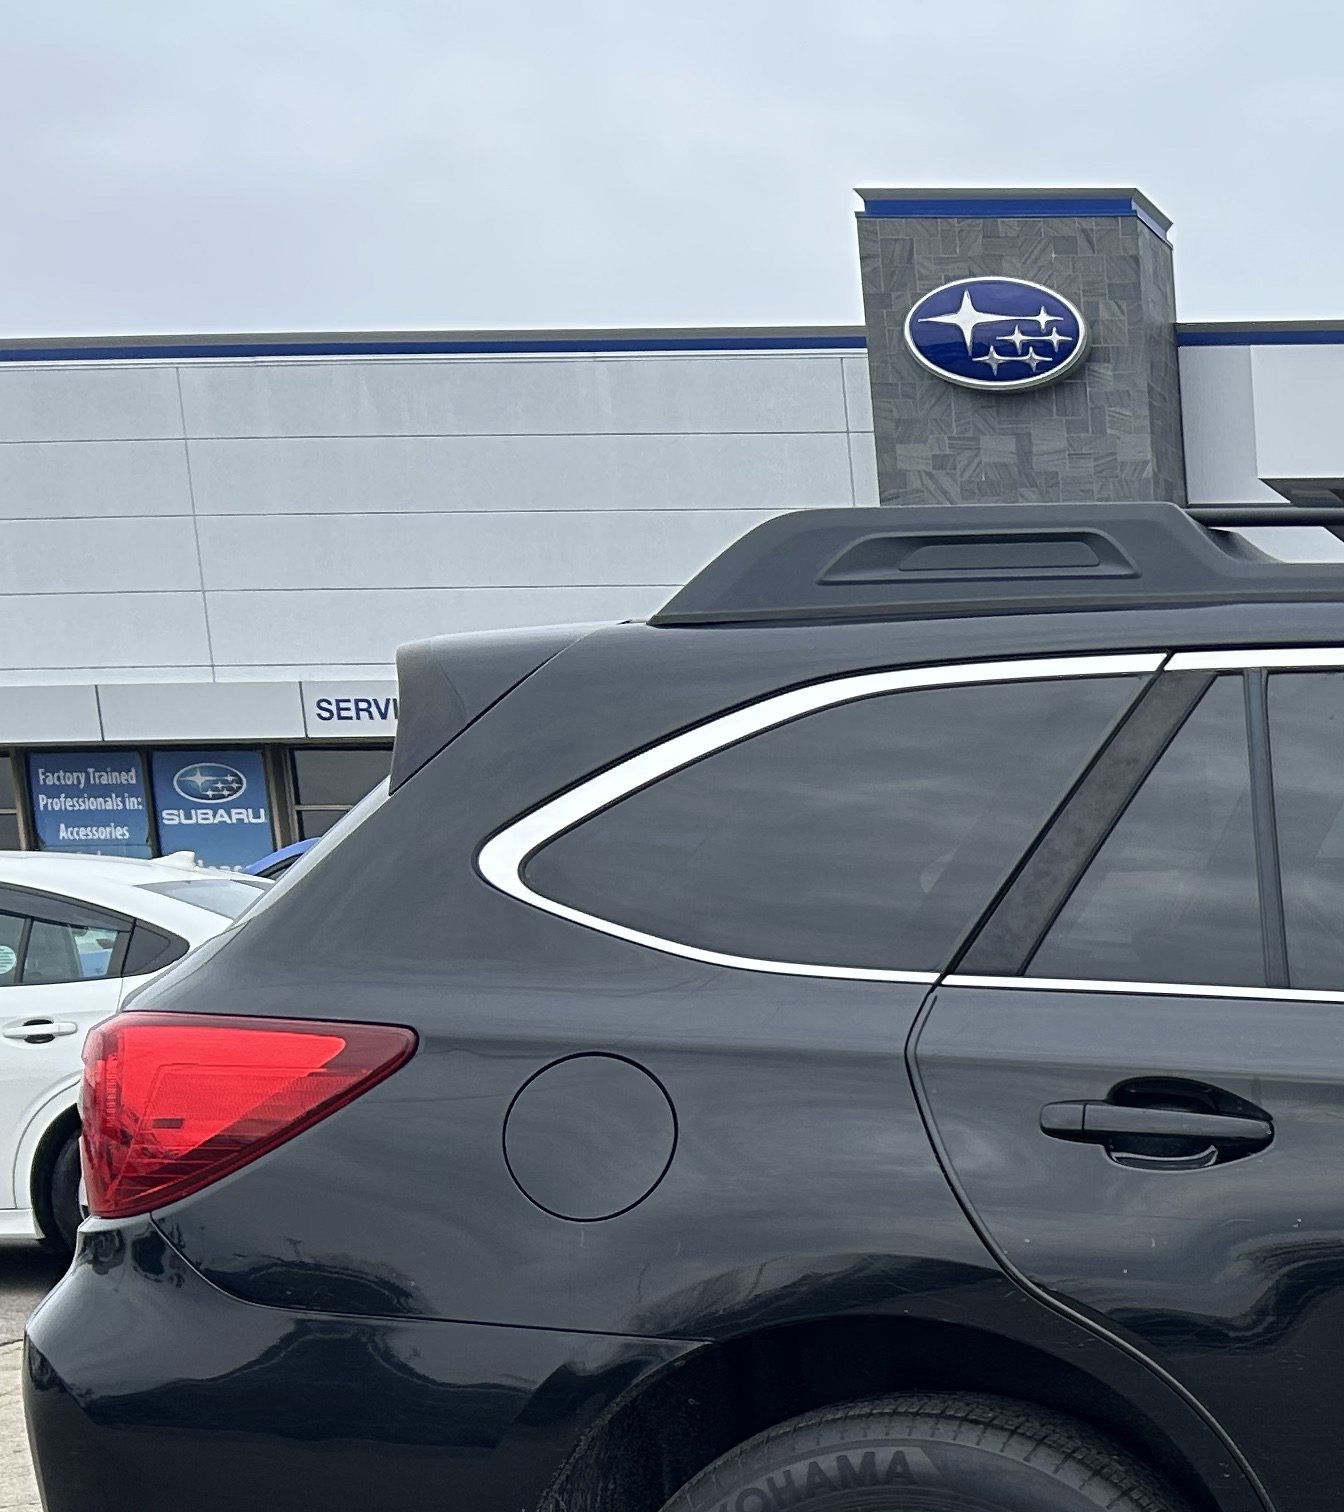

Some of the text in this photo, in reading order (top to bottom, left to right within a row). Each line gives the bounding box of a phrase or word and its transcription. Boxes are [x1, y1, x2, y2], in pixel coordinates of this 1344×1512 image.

[38, 767, 137, 789] Factory Trained
[38, 792, 143, 811] Professionals in:
[161, 807, 266, 825] SUBARU
[59, 822, 130, 840] Accessories
